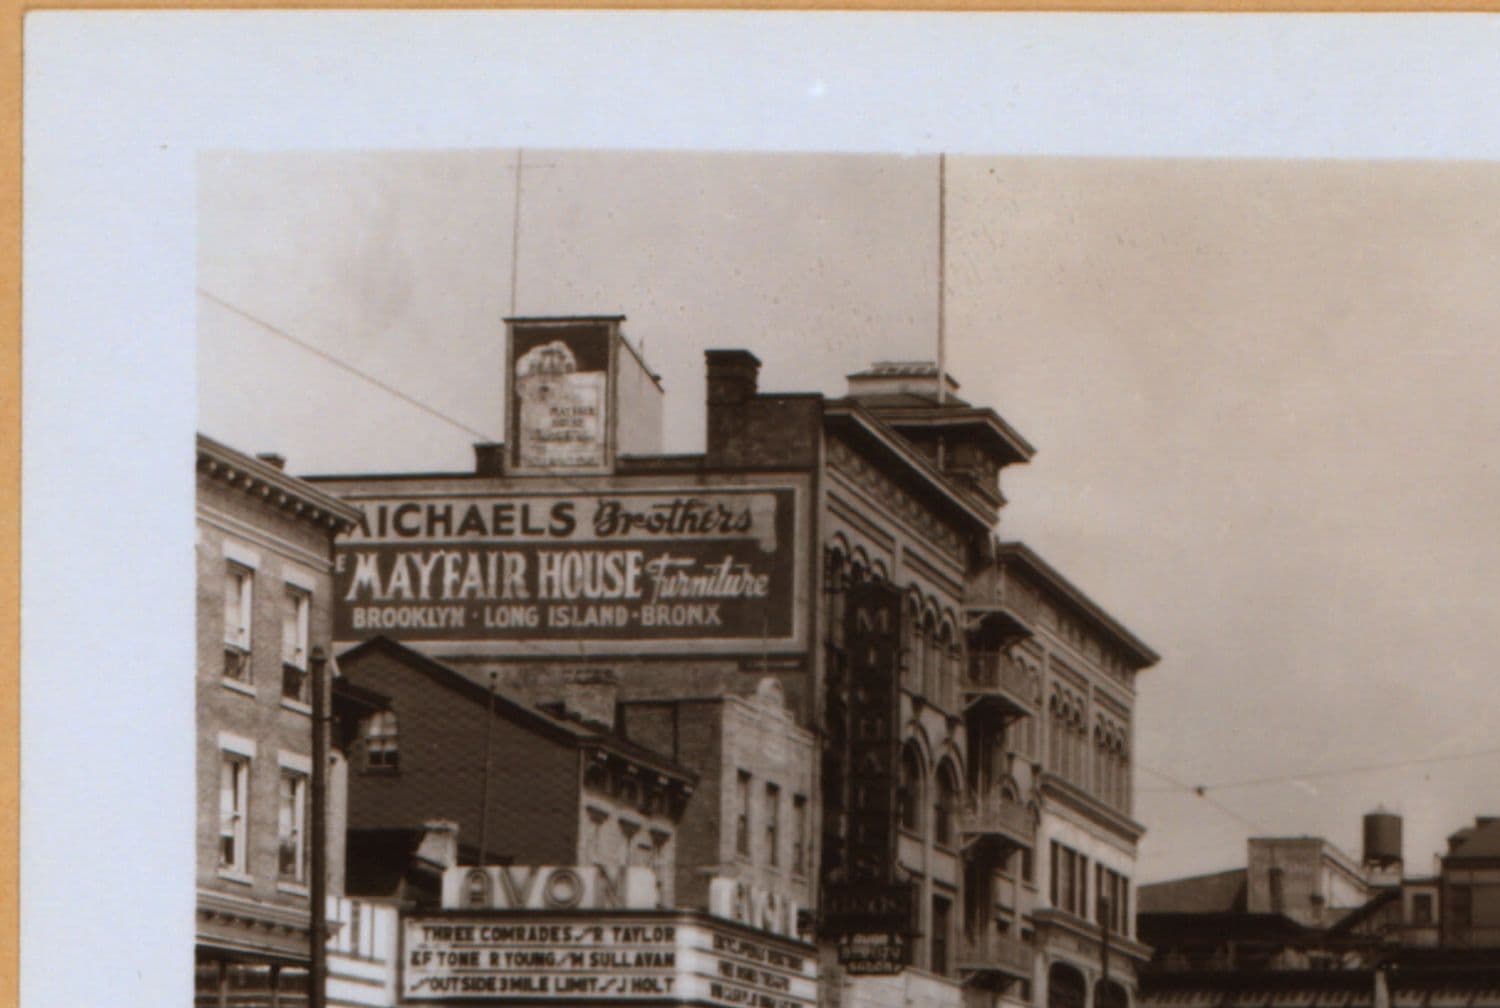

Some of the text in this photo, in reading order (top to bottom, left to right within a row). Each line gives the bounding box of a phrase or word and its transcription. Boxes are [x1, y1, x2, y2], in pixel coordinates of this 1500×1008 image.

[594, 498, 753, 536] Brothers
[344, 551, 530, 600] MAYFAIR
[538, 550, 644, 599] HOUSE
[646, 553, 770, 603] Furniture
[352, 603, 722, 629] BROOKLYN LONG ISLAND BRONX
[460, 866, 627, 908] AVON
[423, 926, 475, 942] THREE
[480, 926, 572, 942] COMRADES
[612, 926, 676, 942] TAYLOR
[438, 952, 480, 968] TONE
[505, 952, 557, 968] YOUNG
[590, 952, 676, 968] SULLAVAN
[555, 977, 600, 993] LIMIT
[631, 977, 676, 993] HOLT
